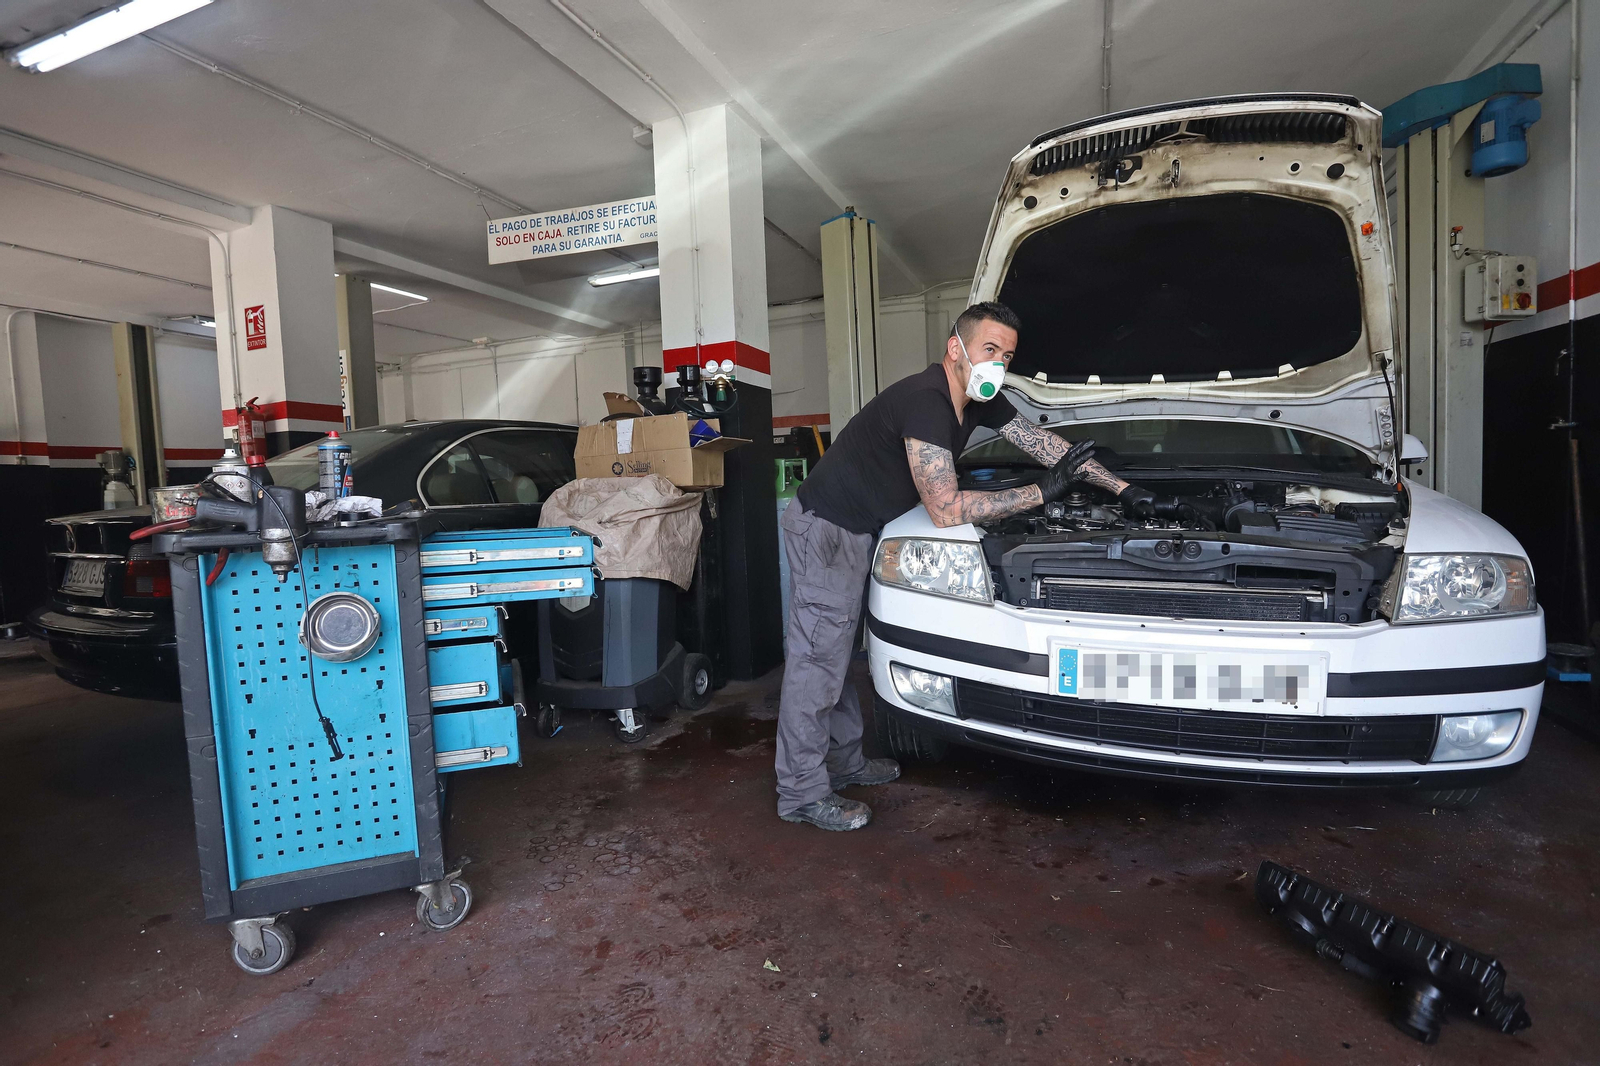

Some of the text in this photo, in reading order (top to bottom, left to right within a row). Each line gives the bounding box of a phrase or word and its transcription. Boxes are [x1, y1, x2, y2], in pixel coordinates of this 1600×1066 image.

[489, 200, 658, 234] EL PAGO DE TRABAJOS SE EFECTUA
[495, 214, 657, 247] SOLO EN CAJA. RETIRE SU FACTUR
[532, 233, 625, 255] PARA SU GARANTIA.
[247, 339, 266, 348] EXTINTOR
[1064, 676, 1071, 687] E
